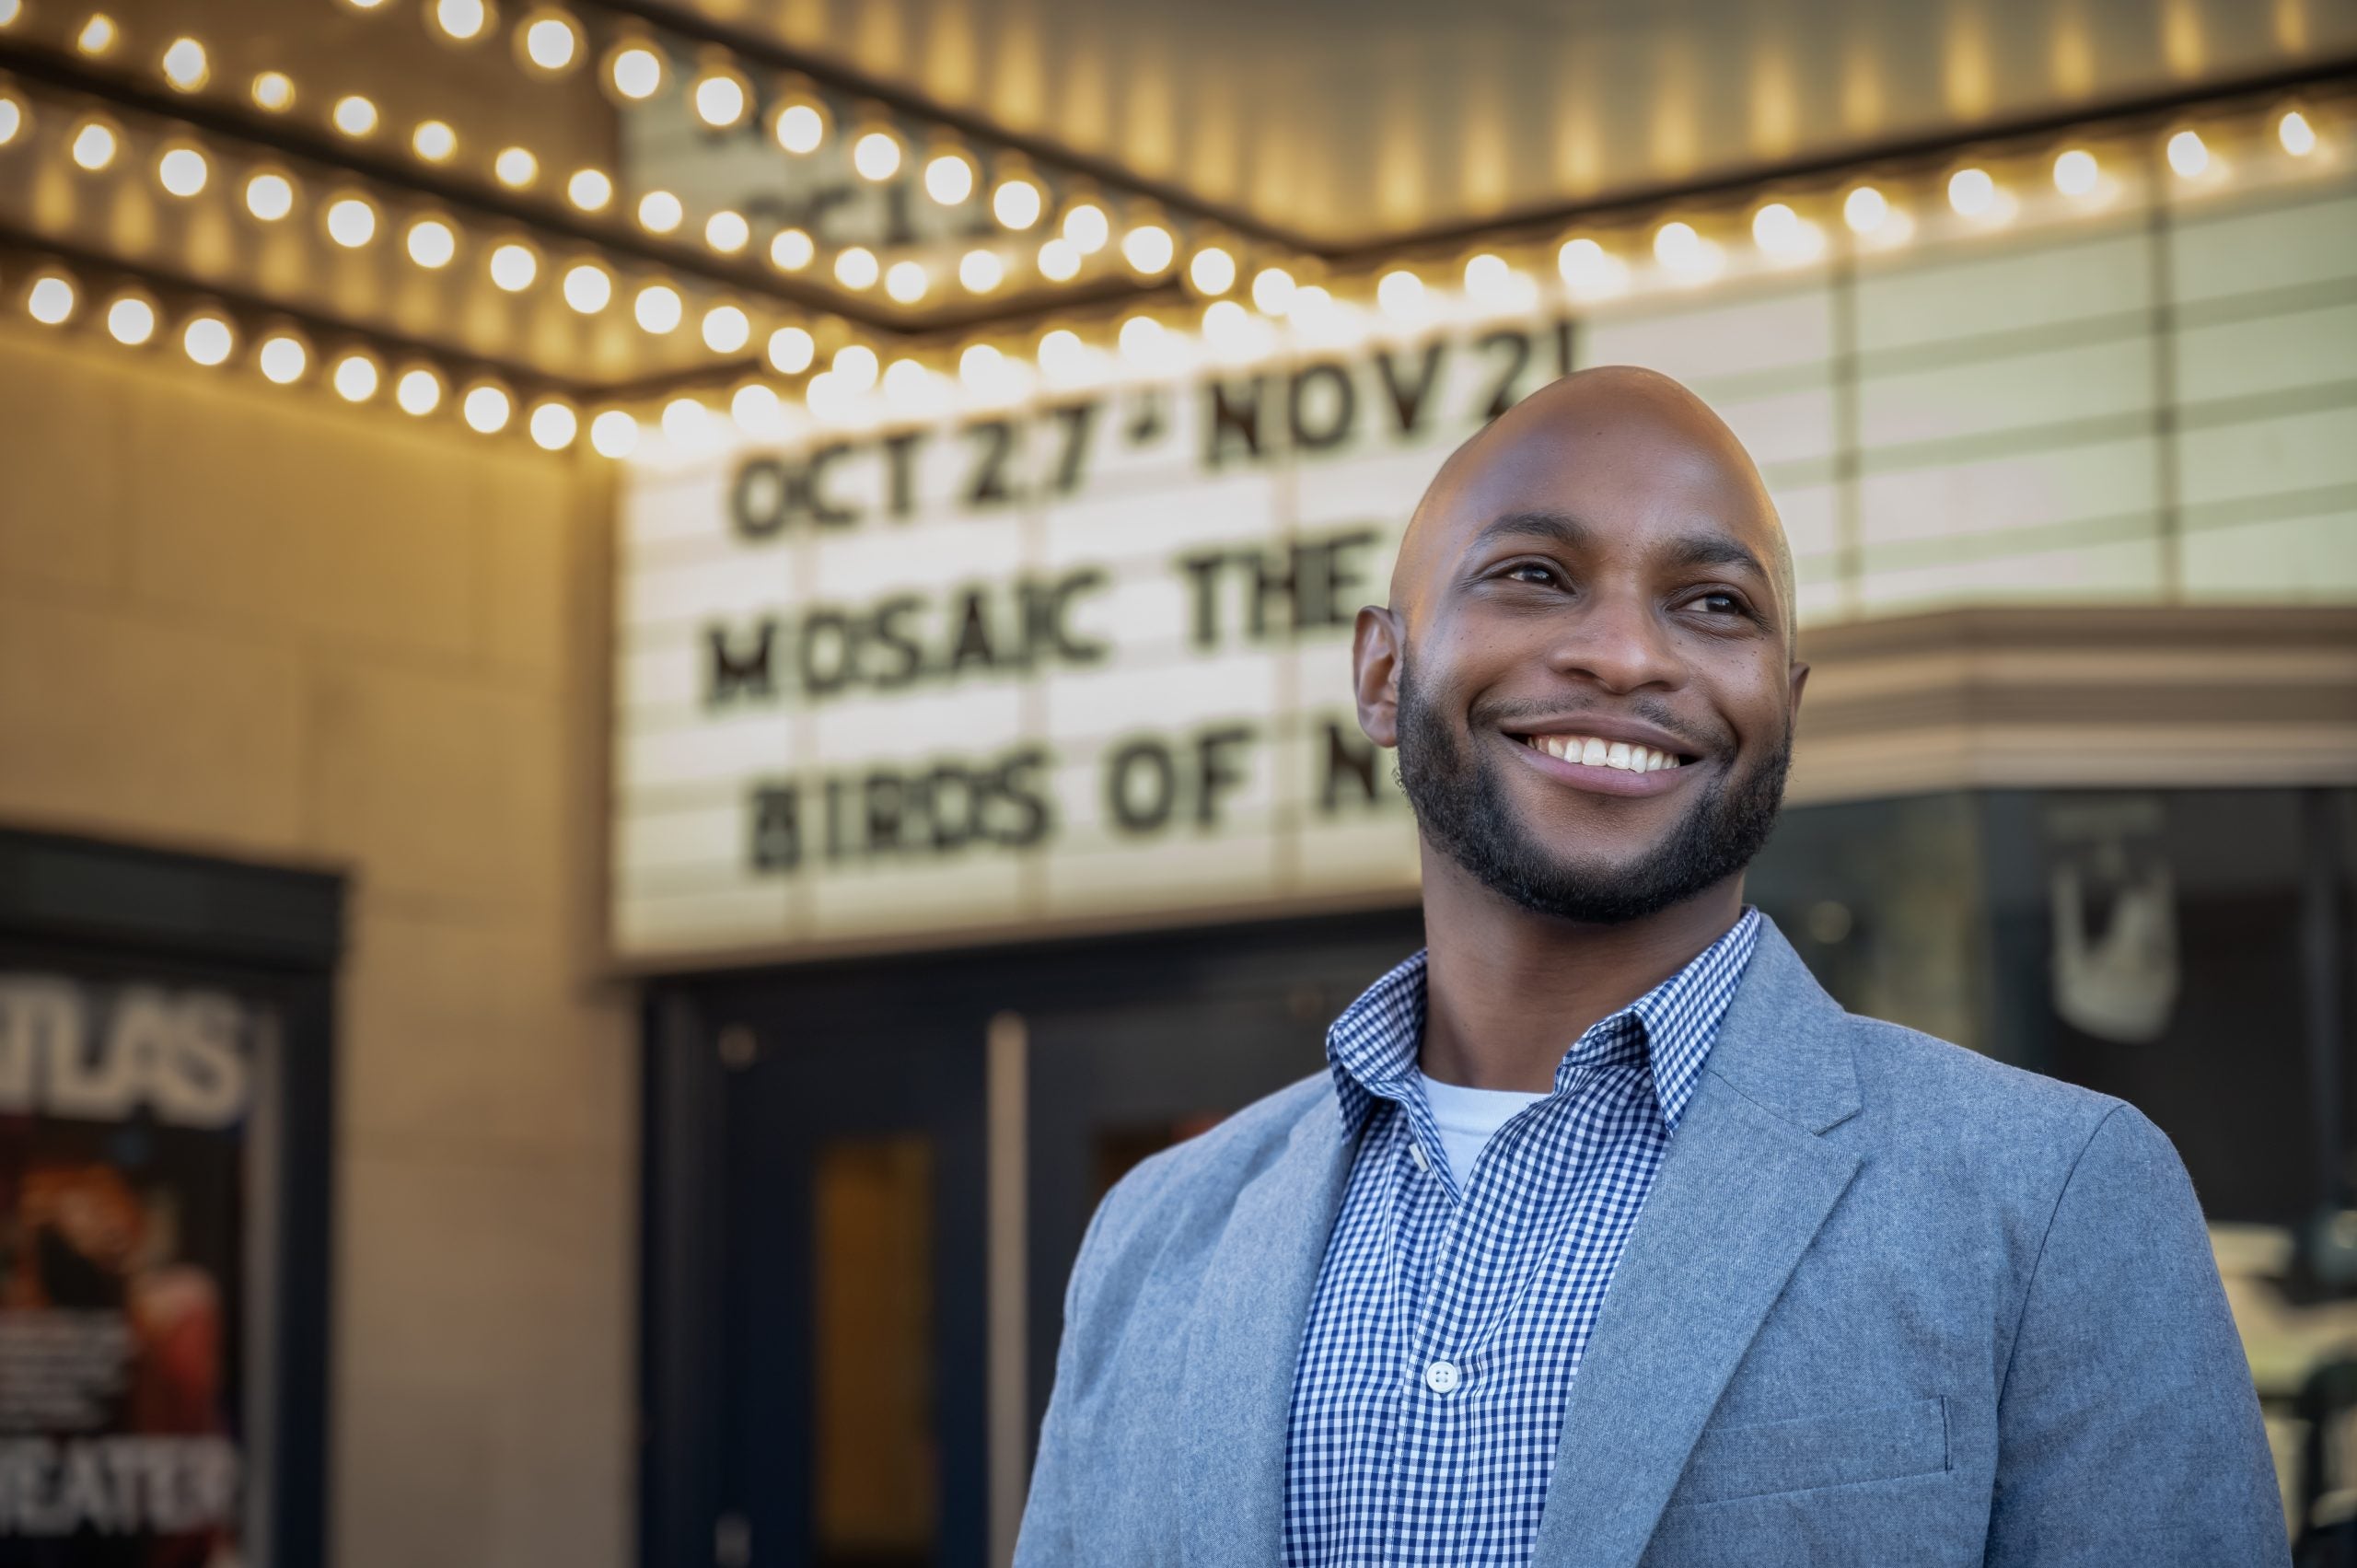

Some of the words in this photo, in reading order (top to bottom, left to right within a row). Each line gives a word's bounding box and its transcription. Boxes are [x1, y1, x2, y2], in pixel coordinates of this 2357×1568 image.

[732, 431, 923, 541] OCT
[959, 402, 1097, 507] 27
[1207, 342, 1446, 463] NOV
[708, 571, 1112, 703] MOSAIC
[1179, 529, 1377, 647] THE
[752, 749, 1055, 873] BIRDS
[1108, 727, 1254, 832] OF
